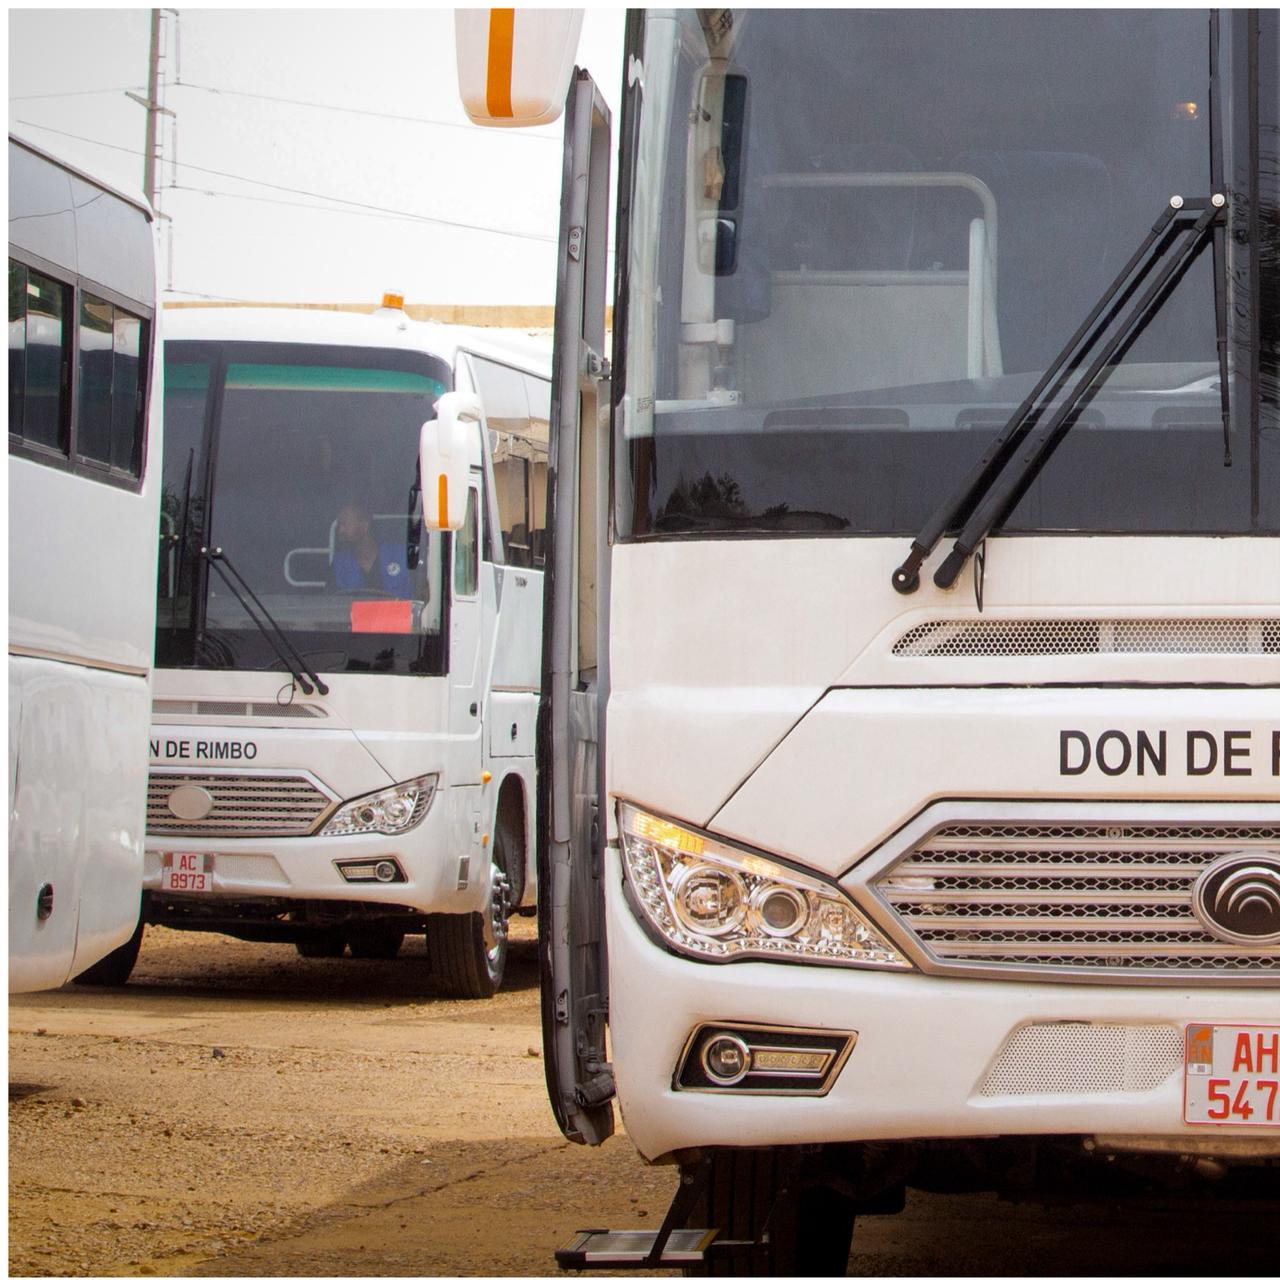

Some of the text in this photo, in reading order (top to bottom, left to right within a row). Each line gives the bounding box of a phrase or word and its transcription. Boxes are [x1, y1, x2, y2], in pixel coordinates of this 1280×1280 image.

[166, 741, 190, 758] DE
[196, 742, 258, 759] RIMBO
[1060, 730, 1167, 776] DON
[1187, 730, 1252, 776] DE
[180, 855, 196, 870] AC
[171, 873, 205, 889] 8973
[1232, 1032, 1279, 1073] AH
